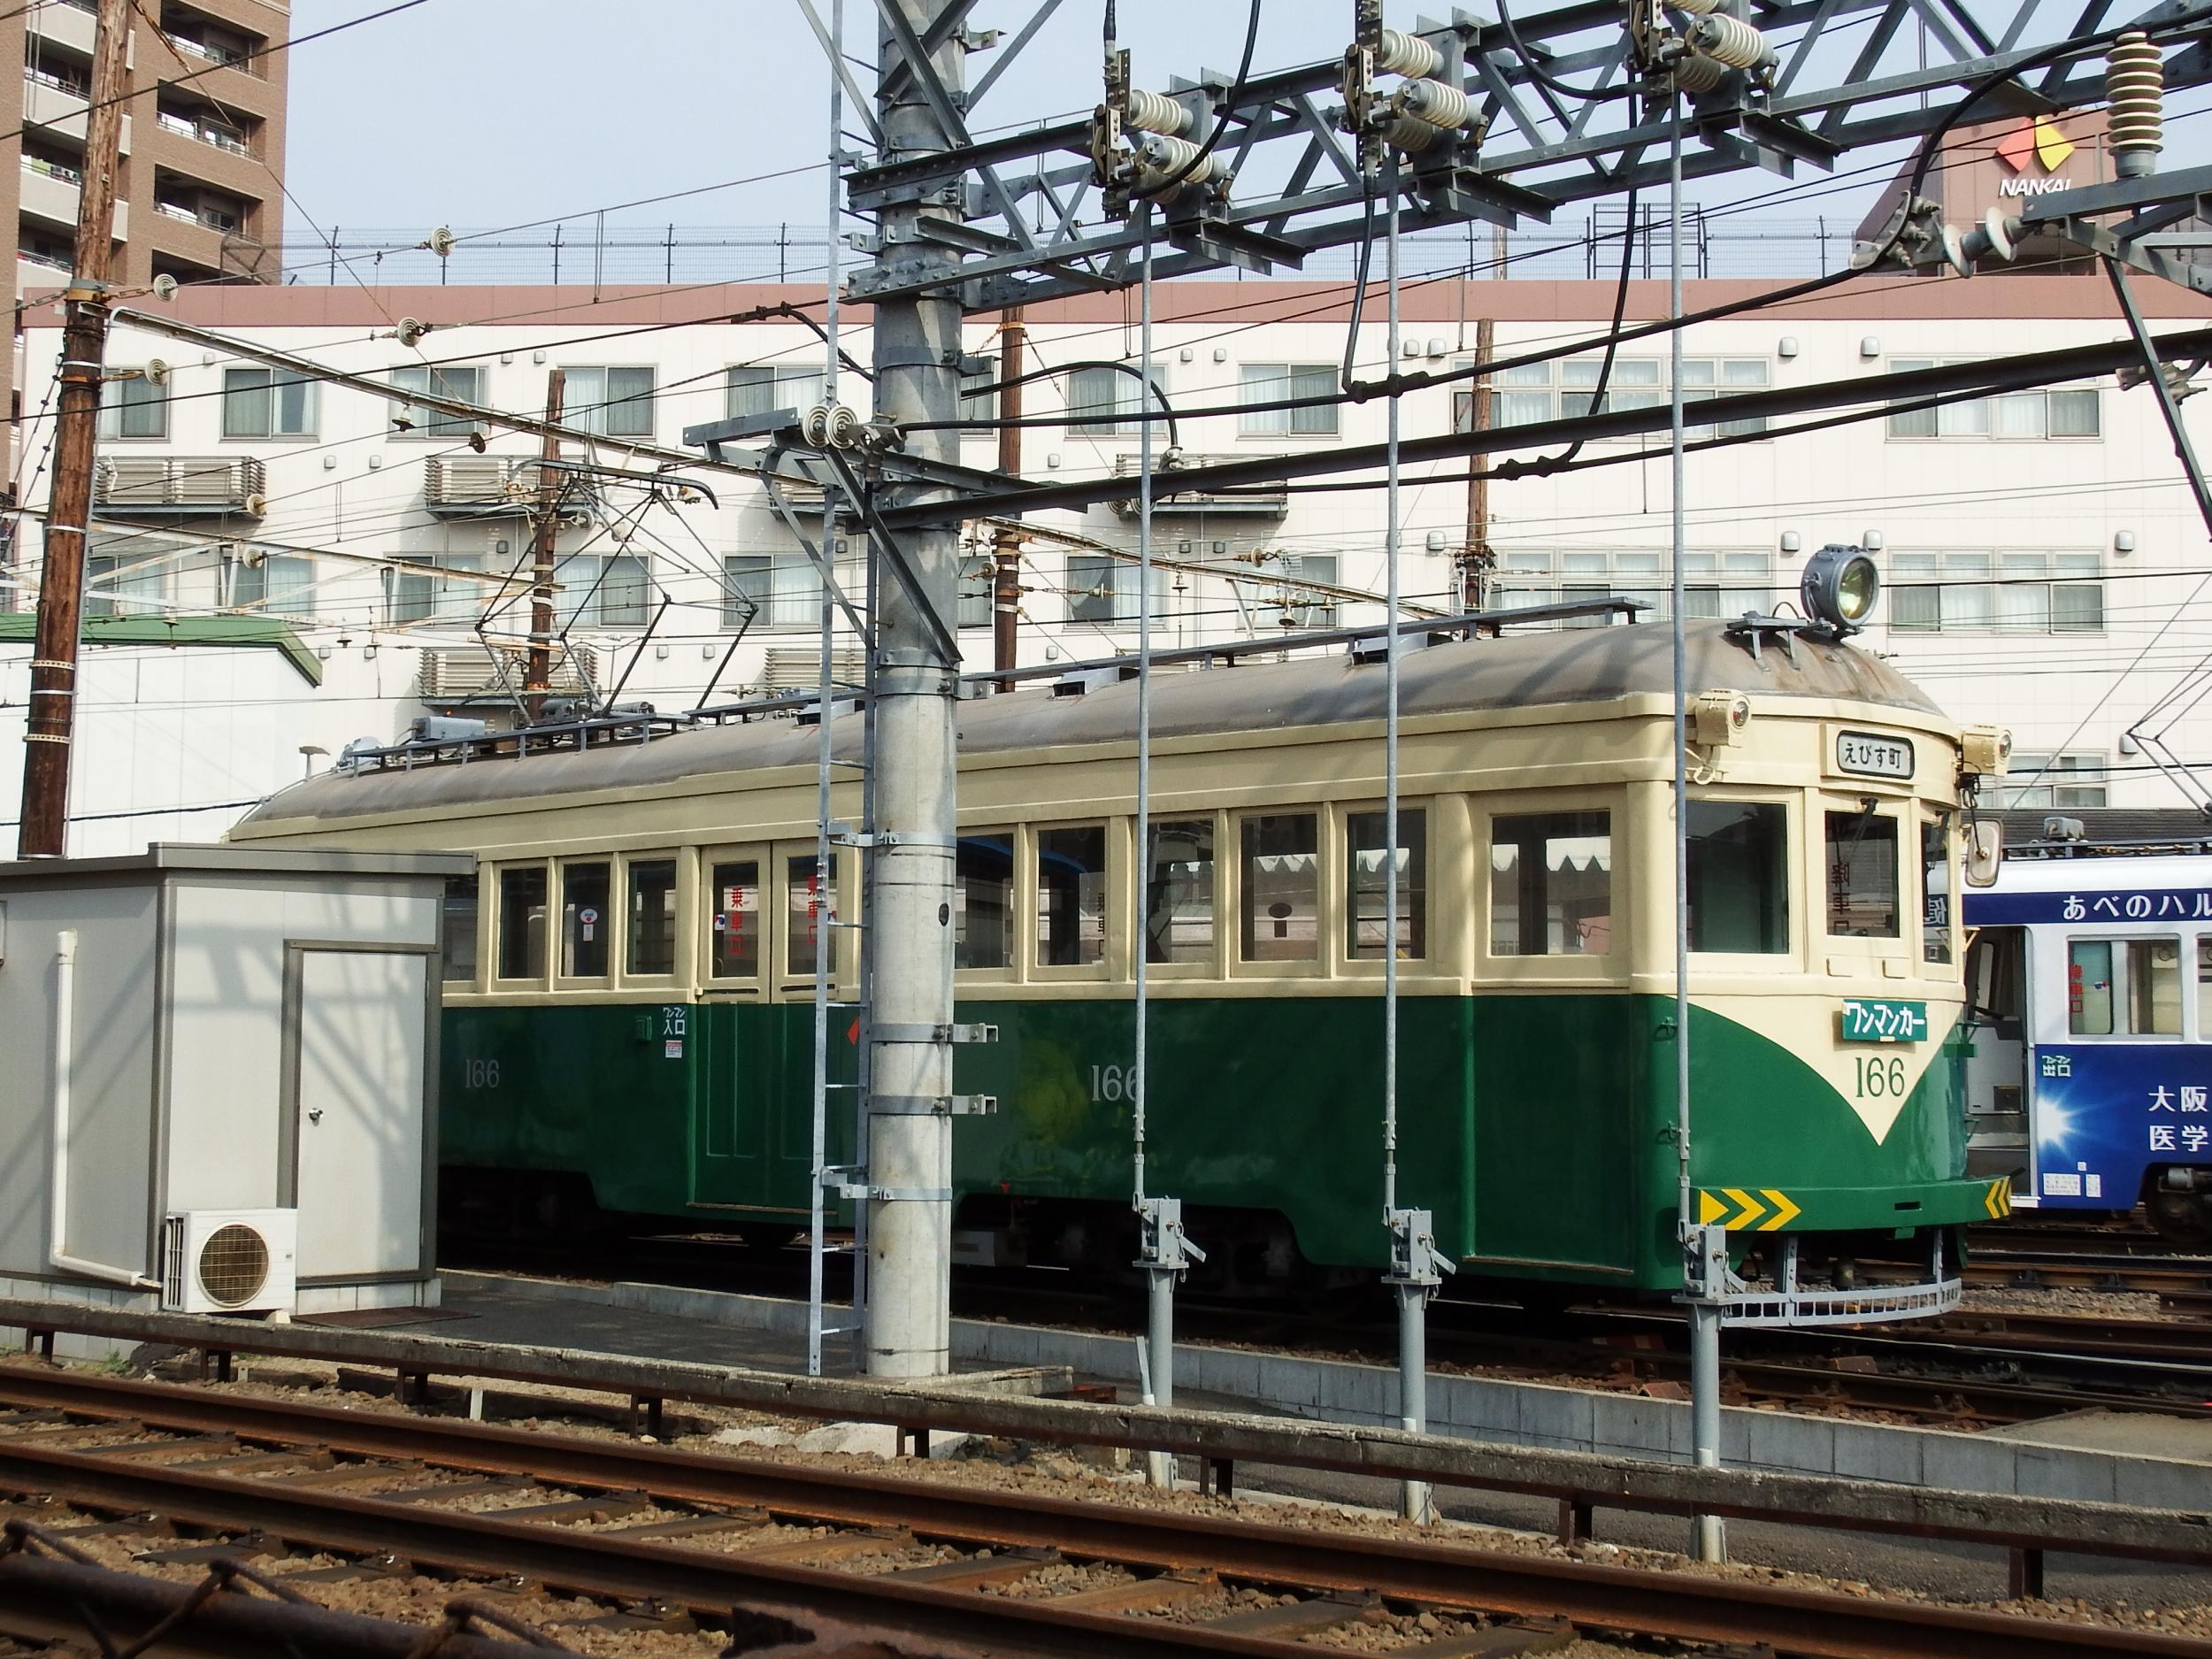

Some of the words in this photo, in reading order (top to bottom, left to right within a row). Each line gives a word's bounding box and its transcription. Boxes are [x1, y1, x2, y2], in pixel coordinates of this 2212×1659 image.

[1999, 179, 2071, 196] NANKAI
[1845, 743, 1901, 770] えびす町
[2062, 893, 2212, 920] あべのハル
[730, 887, 743, 956] 乗車口
[663, 1007, 686, 1018] ワンマン
[1842, 1002, 1926, 1037] ワンマンカー
[663, 1018, 686, 1035] 入口
[465, 1058, 500, 1088] 166
[1855, 1056, 1905, 1098] 166
[2042, 1064, 2071, 1077] 出口
[2147, 1085, 2209, 1112] 大阪
[2149, 1125, 2209, 1152] 医学
